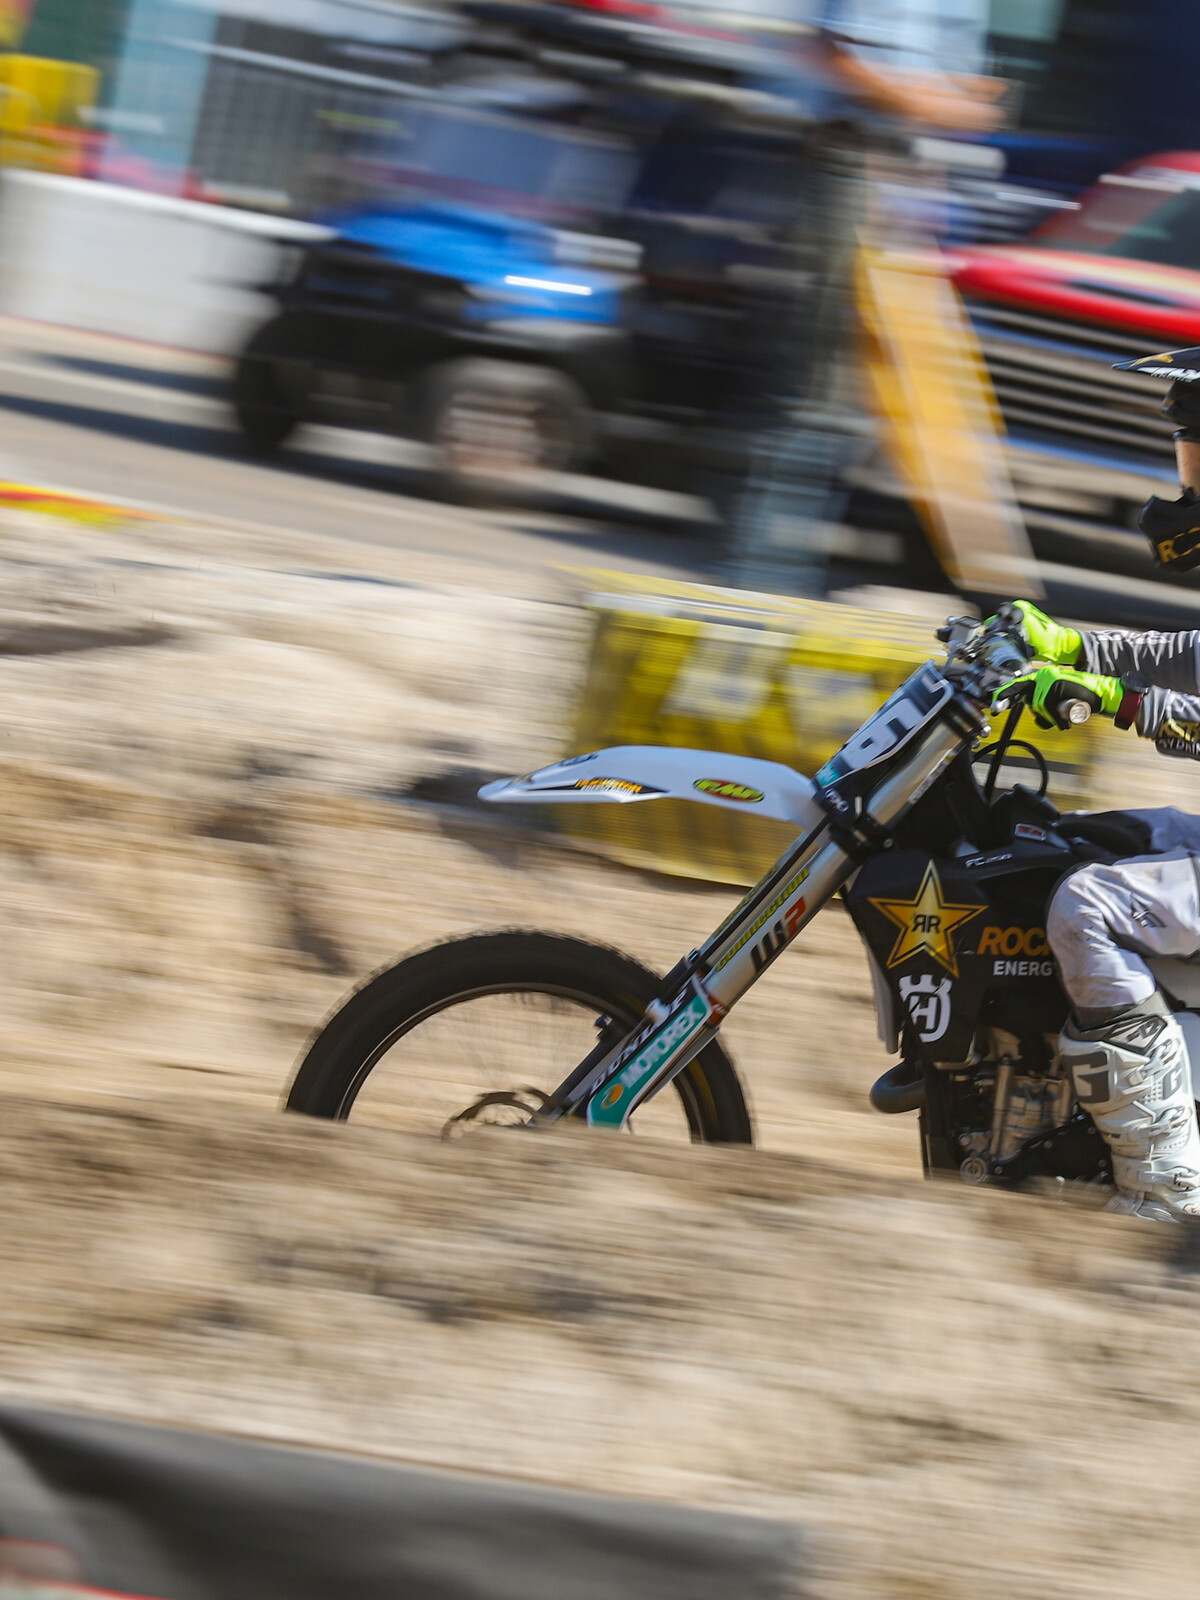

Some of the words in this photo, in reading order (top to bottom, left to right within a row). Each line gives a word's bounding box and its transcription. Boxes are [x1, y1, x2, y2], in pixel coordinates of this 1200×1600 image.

[977, 926, 1052, 956] ROC
[993, 960, 1062, 976] ENERG
[619, 1004, 704, 1089] MOTOREX
